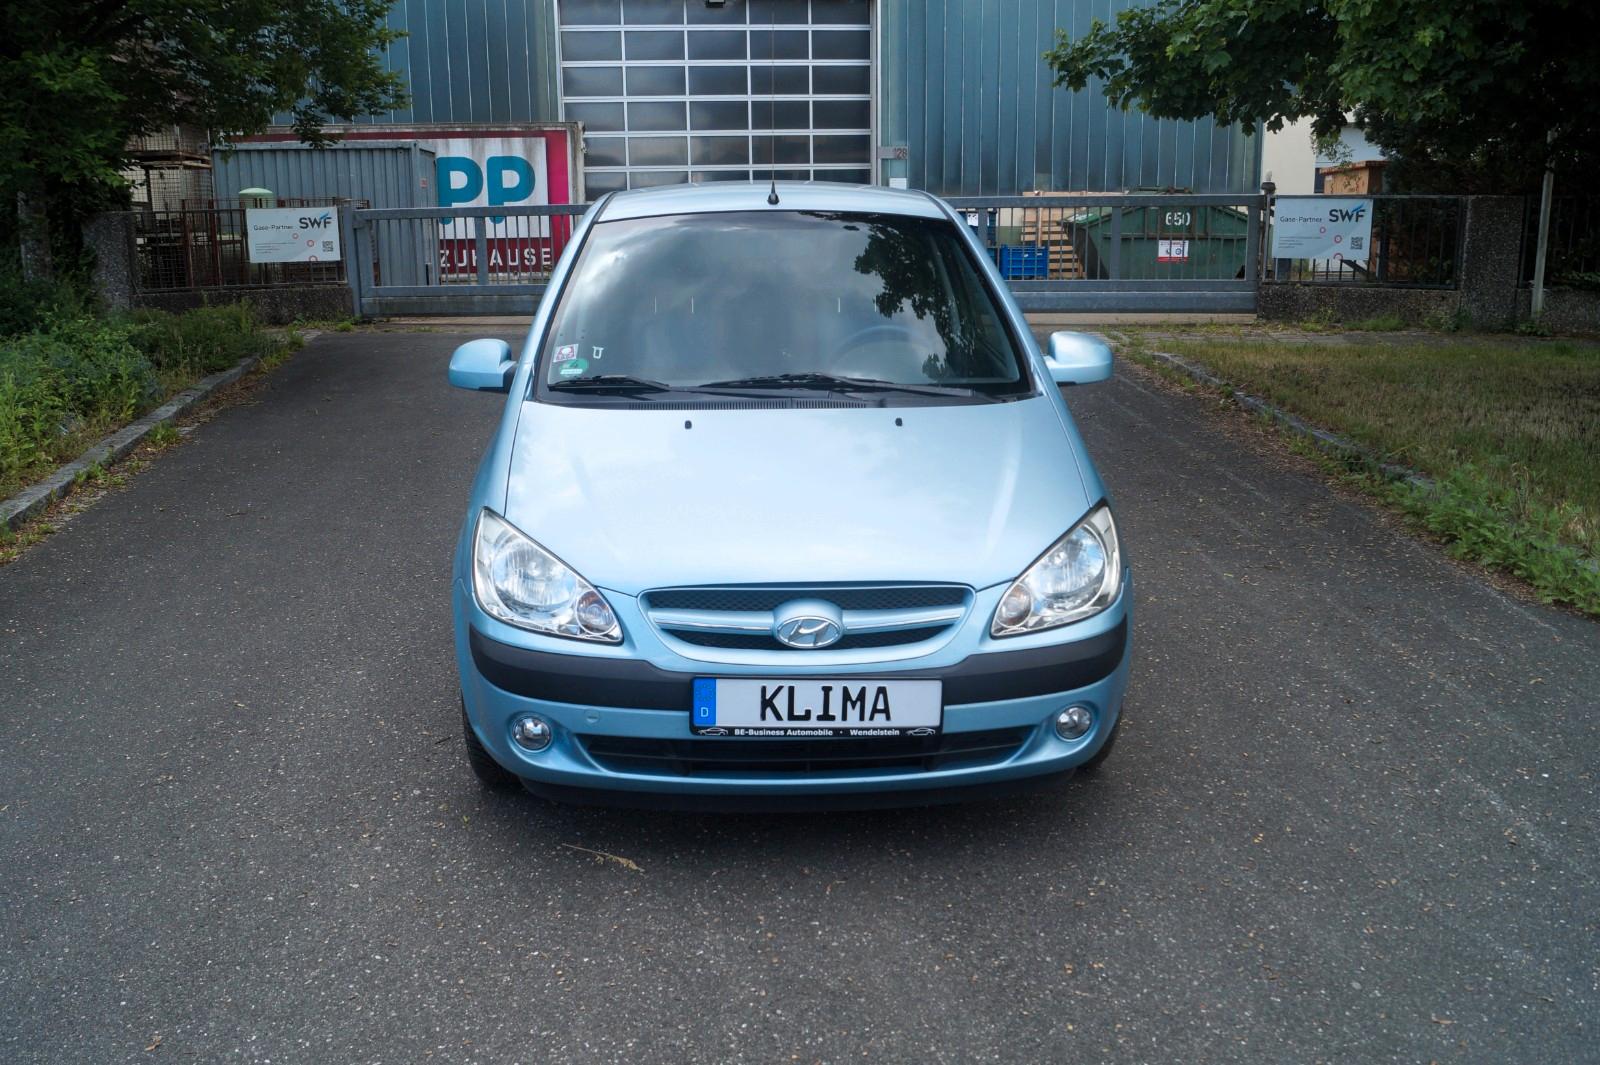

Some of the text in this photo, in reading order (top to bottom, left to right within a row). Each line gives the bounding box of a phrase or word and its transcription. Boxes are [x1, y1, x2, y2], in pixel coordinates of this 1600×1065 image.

[1165, 212, 1191, 226] 650
[1329, 208, 1366, 223] SWF
[299, 216, 332, 230] SWF
[760, 685, 892, 722] KLIMA
[700, 707, 709, 718] D
[734, 728, 900, 736] BE-Business Automobile Wendelstein
